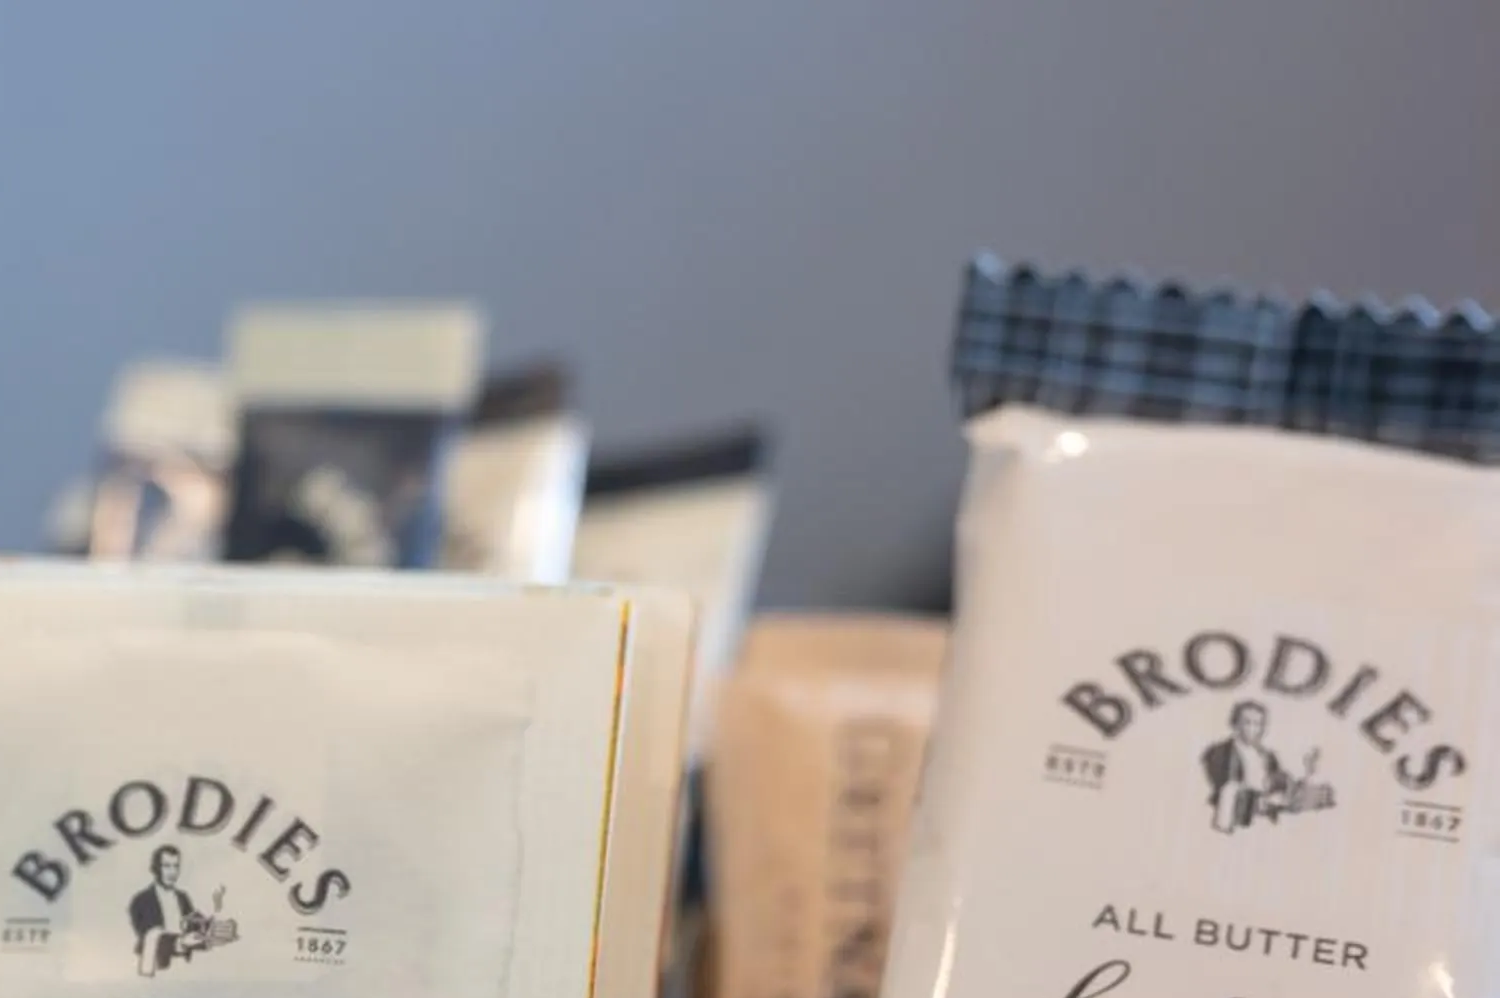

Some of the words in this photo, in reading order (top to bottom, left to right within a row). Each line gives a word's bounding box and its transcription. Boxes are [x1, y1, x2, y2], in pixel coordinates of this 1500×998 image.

[1061, 630, 1467, 791] BRODIES
[10, 777, 352, 915] BRODIES
[1400, 810, 1462, 834] 1867
[295, 936, 347, 956] 1867
[1091, 904, 1176, 941] ALL
[1194, 918, 1369, 970] BUTTER
